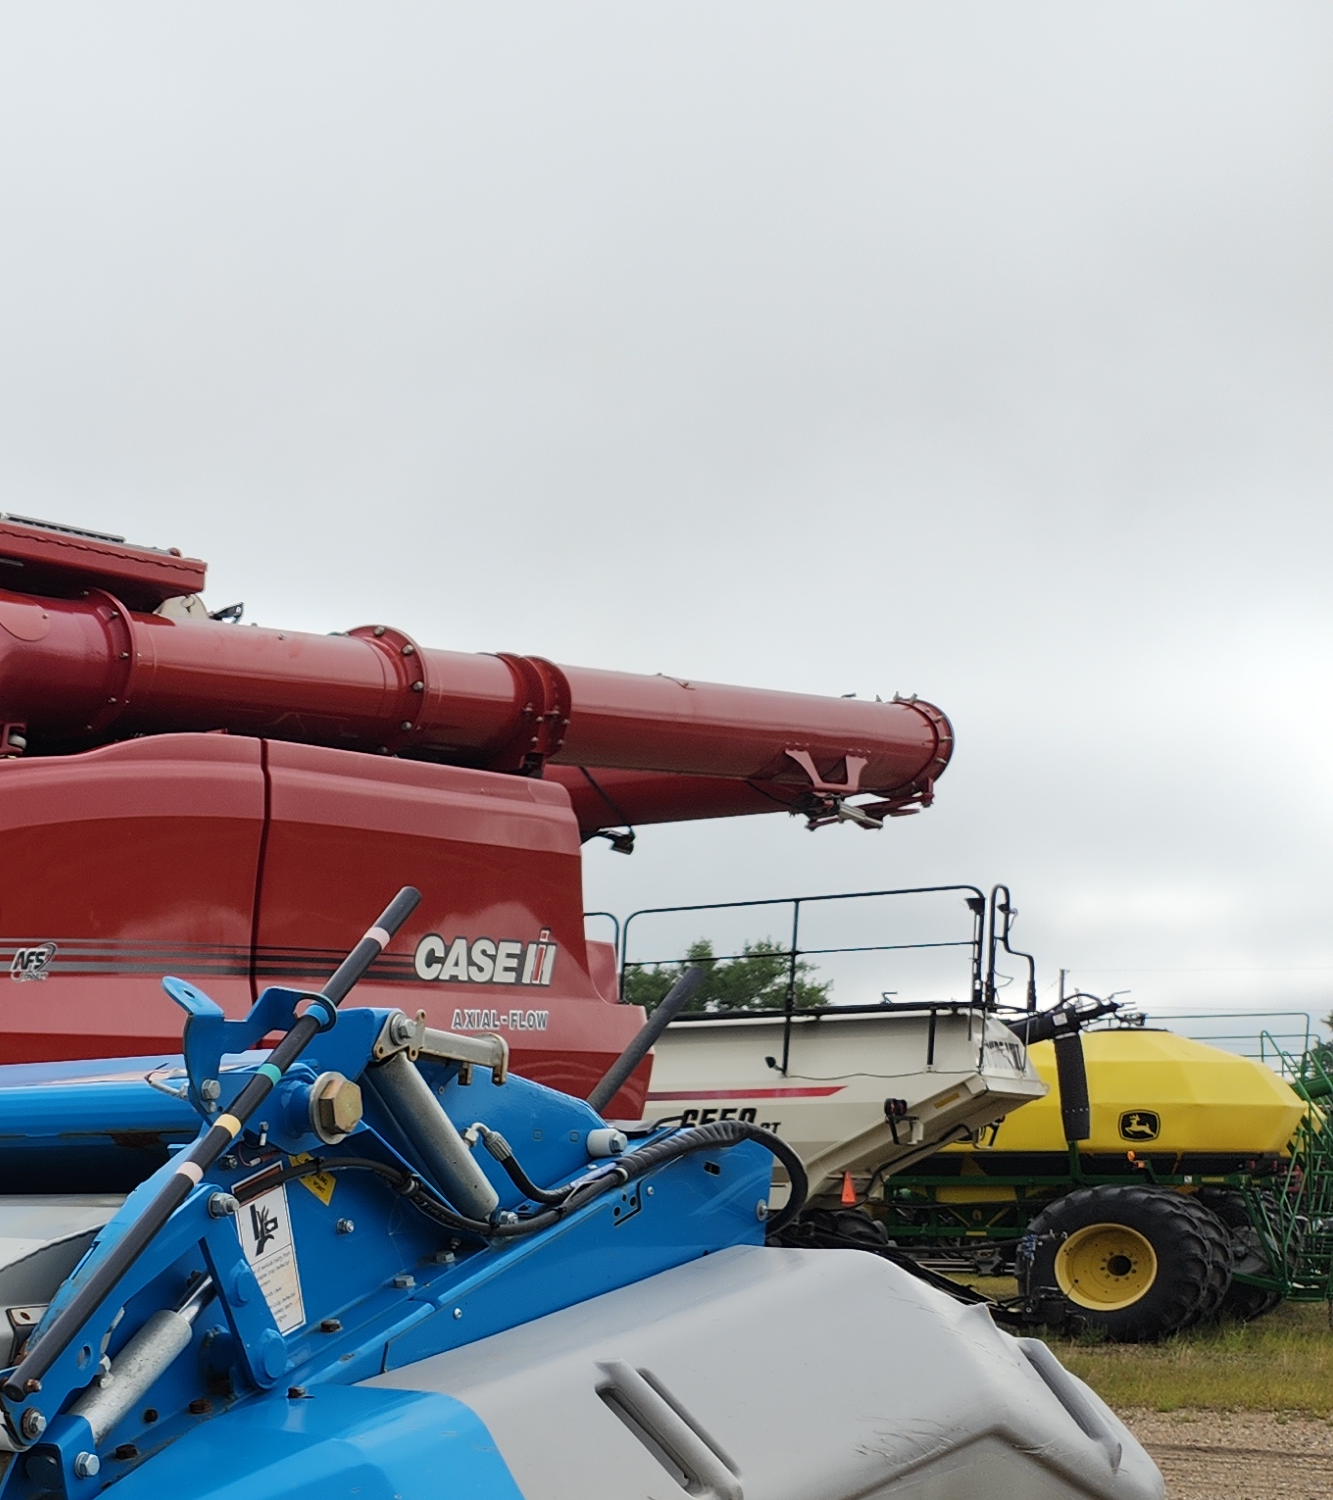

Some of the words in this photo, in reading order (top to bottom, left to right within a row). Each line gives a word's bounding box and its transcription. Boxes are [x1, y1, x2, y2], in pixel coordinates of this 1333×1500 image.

[10, 947, 50, 971] AFS
[414, 934, 522, 983] CASE
[450, 1008, 549, 1031] AXIAL-FLOW
